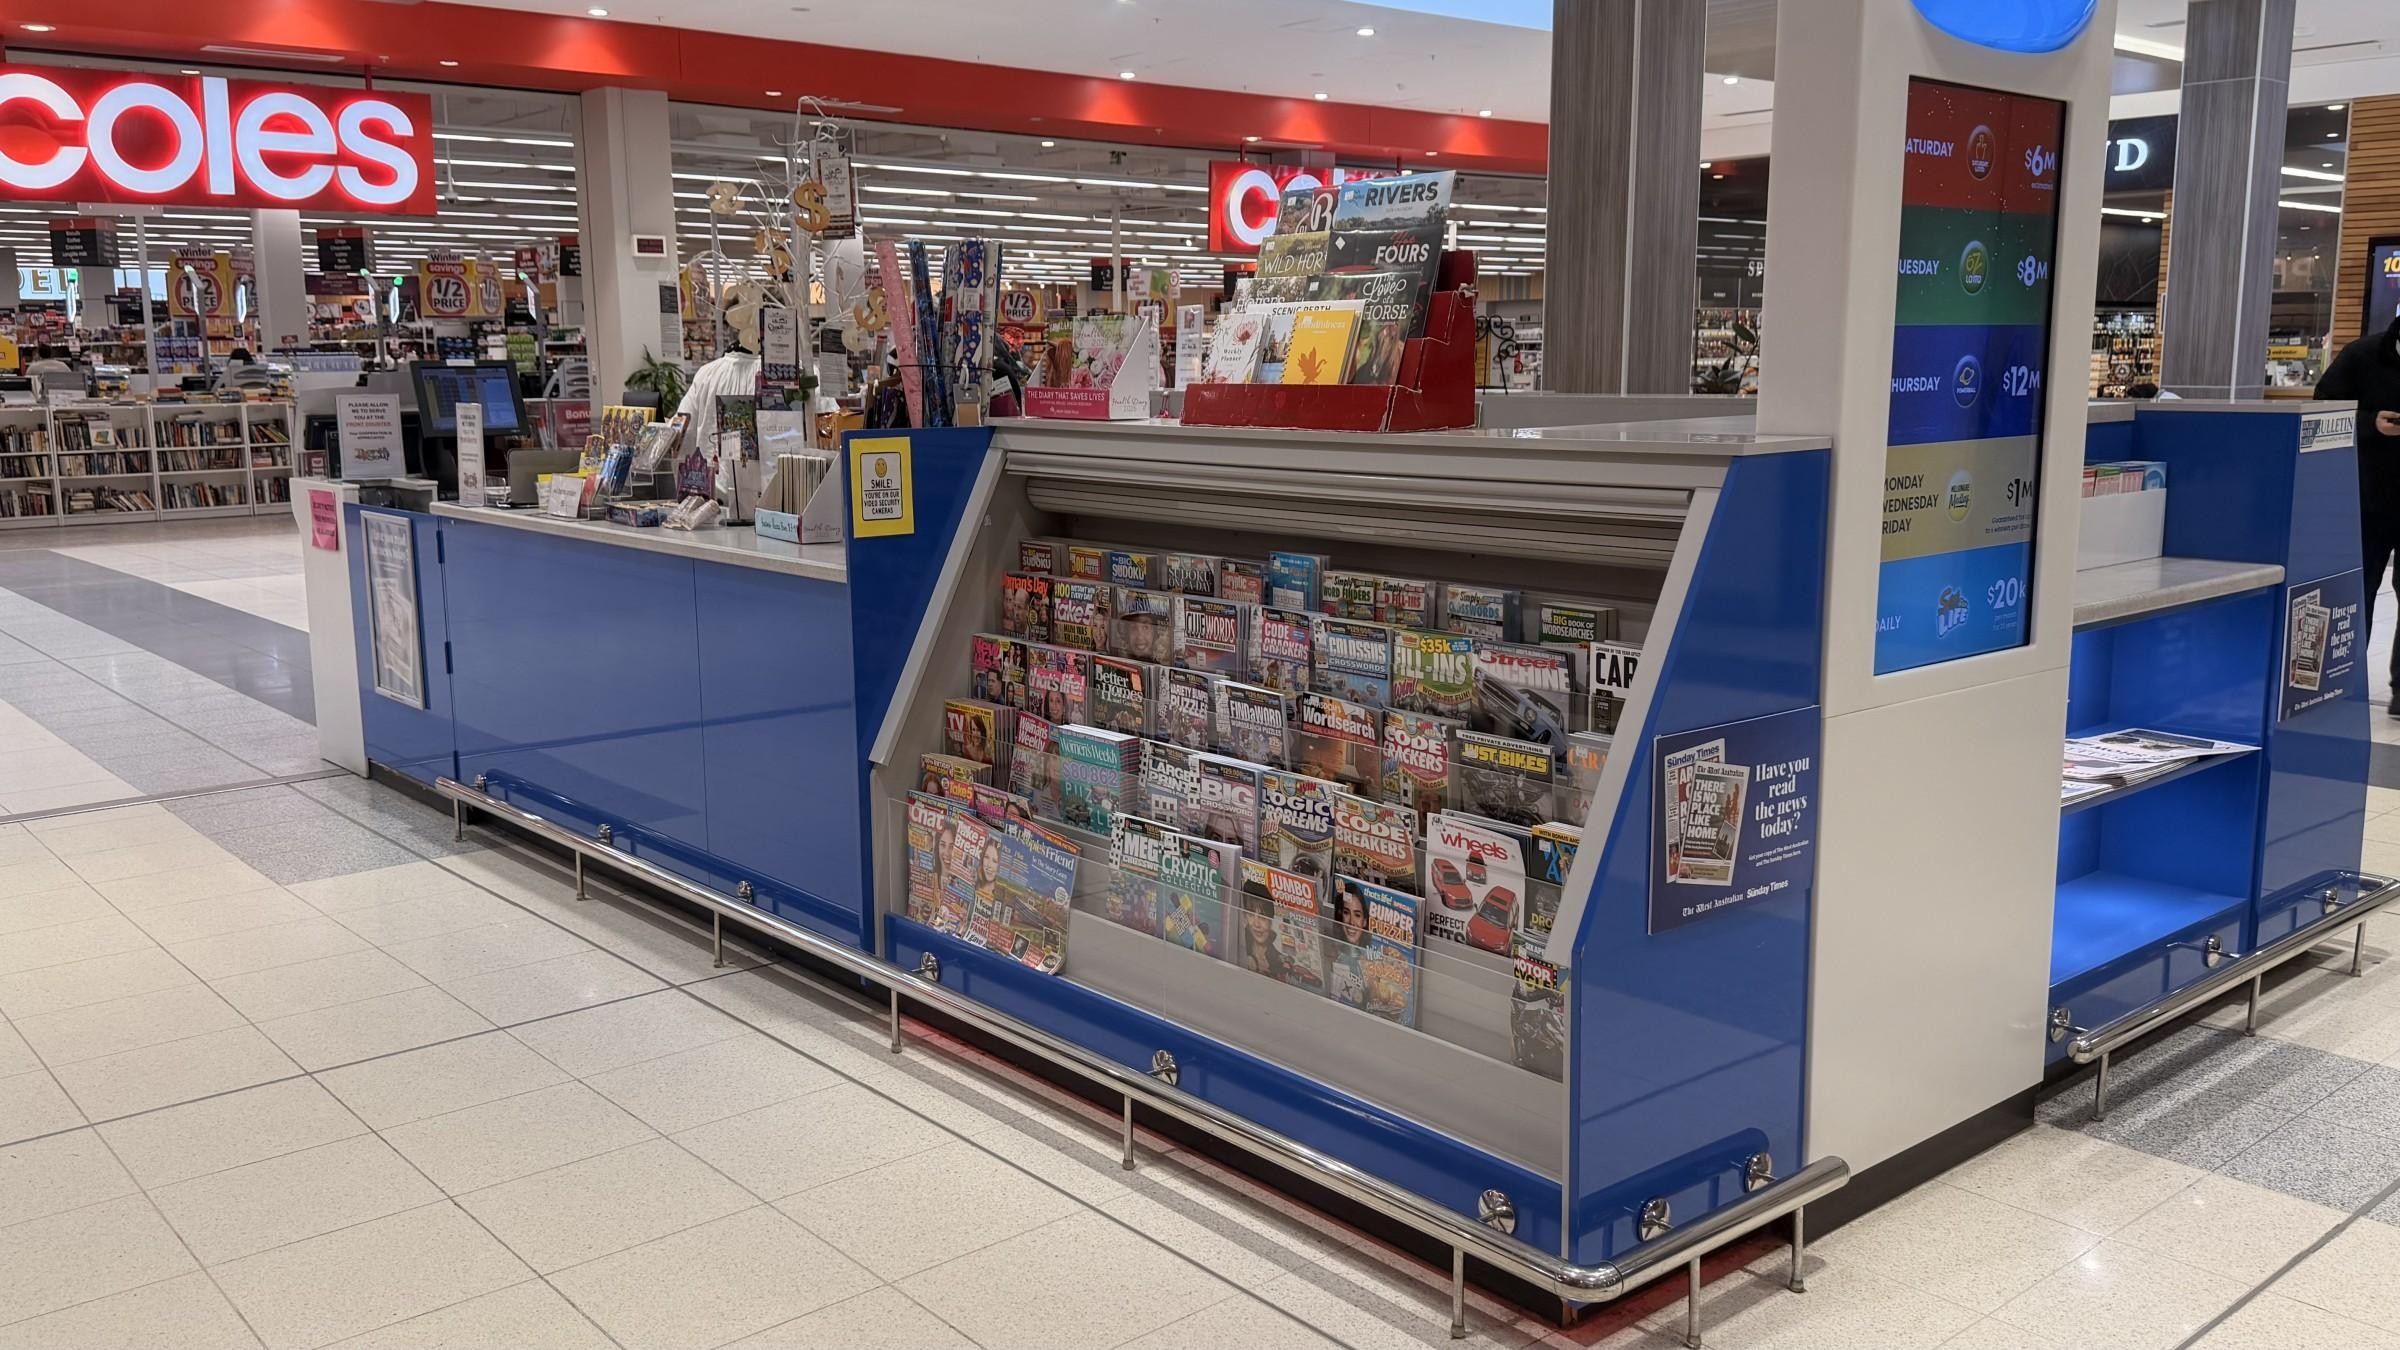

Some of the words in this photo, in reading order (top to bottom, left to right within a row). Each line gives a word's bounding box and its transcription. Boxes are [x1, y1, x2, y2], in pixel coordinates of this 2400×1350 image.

[0, 73, 418, 205] coles
[1905, 138, 1954, 157] ATURDAY
[2025, 145, 2056, 176] $6M
[1365, 181, 1438, 207] RIVERS
[179, 248, 211, 257] Winter
[430, 253, 461, 262] Winter
[1264, 254, 1295, 273] WILD
[1298, 251, 1328, 271] HOR
[1376, 244, 1429, 264] FOURS
[428, 264, 466, 275] savings
[1899, 259, 1940, 275] UESDAY
[2017, 255, 2048, 287] $8M
[433, 278, 464, 298] 1/2
[433, 298, 465, 309] PRICE
[1007, 293, 1031, 309] 1/2
[1006, 308, 1032, 318] PRICE
[1363, 304, 1408, 321] HORSE
[1892, 377, 1940, 392] HURSDAY
[2003, 366, 2040, 396] $12M
[1028, 390, 1038, 399] THE
[1039, 390, 1054, 399] DIARY
[1055, 391, 1069, 400] THAT
[1070, 391, 1088, 401] SAVES
[1089, 392, 1105, 401] LIVES
[565, 409, 590, 420] Bonu
[871, 479, 892, 489] SMILE!
[2007, 478, 2033, 508] $1M
[872, 507, 894, 515] CAMERAS
[879, 499, 900, 507] SECURITY
[1882, 518, 1912, 535] RIDAY
[1022, 555, 1051, 569] SUDOKU
[1118, 557, 1131, 565] BIG
[1112, 564, 1145, 580] SUDOKU
[1334, 575, 1354, 589] Simply
[1034, 577, 1049, 598] Day
[1323, 586, 1341, 598] WORD
[1342, 587, 1371, 602] FINDERS
[1459, 591, 1481, 606] Simply
[2333, 606, 2348, 619] Have
[2347, 603, 2357, 615] you
[1264, 622, 1290, 640] CODE
[1553, 615, 1568, 626] BIG
[1568, 620, 1584, 629] BOOK
[1585, 621, 1595, 629] OF
[1938, 608, 1968, 637] LIFE
[2338, 617, 2350, 632] read
[1542, 625, 1594, 641] WORDSEARCHES
[2331, 634, 2340, 646] the
[2341, 630, 2355, 644] news
[1262, 638, 1309, 661] CRACKERS
[1329, 636, 1386, 665] COLOSSUS
[1420, 639, 1452, 653] $35k
[1329, 657, 1386, 673] CROSSWORDS
[1394, 646, 1467, 685] FILL-INS
[1480, 650, 1561, 670] Street
[1101, 682, 1143, 704] Homes
[1455, 690, 1471, 701] FUN!
[1170, 694, 1209, 721] PUZZLES
[947, 711, 965, 731] TV
[1020, 715, 1049, 740] Woman's
[1303, 705, 1376, 741] Wordsearch
[1018, 730, 1046, 752] Weekly
[1060, 737, 1092, 758] Women's
[1384, 725, 1447, 756] CODE
[1477, 736, 1500, 746] PRIVATE
[1502, 741, 1544, 753] ADVERTISING
[1383, 740, 1444, 774] CRACKERS
[1502, 750, 1548, 774] BIKES
[1667, 752, 1696, 768] Sunday
[1696, 745, 1720, 758] Times
[1149, 758, 1191, 781] LARGE
[1755, 761, 1787, 782] Have
[1787, 757, 1811, 778] you
[1200, 778, 1254, 809] BIG
[1695, 779, 1727, 793] THERE
[1768, 774, 1796, 799] read
[1261, 789, 1331, 817] LOGIC
[1693, 790, 1702, 802] IS
[1702, 791, 1718, 803] NO
[1200, 799, 1253, 817] CROSSWORD
[1691, 802, 1722, 816] PLACE
[1755, 801, 1775, 821] the
[1777, 796, 1808, 814] news
[1261, 803, 1329, 834] PROBLEMS
[1335, 812, 1406, 843] CODE
[1689, 814, 1712, 827] LIKE
[1760, 811, 1801, 839] today?
[957, 819, 979, 841] Take
[1686, 826, 1718, 840] HOME
[954, 836, 982, 859] Break
[1335, 827, 1407, 860] BREAKERS
[1440, 831, 1509, 862] wheels
[1045, 845, 1075, 871] Friend
[1162, 854, 1218, 890] CRYPTIC
[1160, 873, 1218, 899] COLLECTION
[1271, 872, 1312, 899] JUMBO
[1747, 885, 1770, 900] Sunday
[1770, 879, 1789, 892] Times
[1714, 893, 1744, 909] Australian
[1369, 901, 1414, 932] BUMPER
[1429, 911, 1465, 930] PERFECT
[1513, 957, 1551, 983] MOTOR
